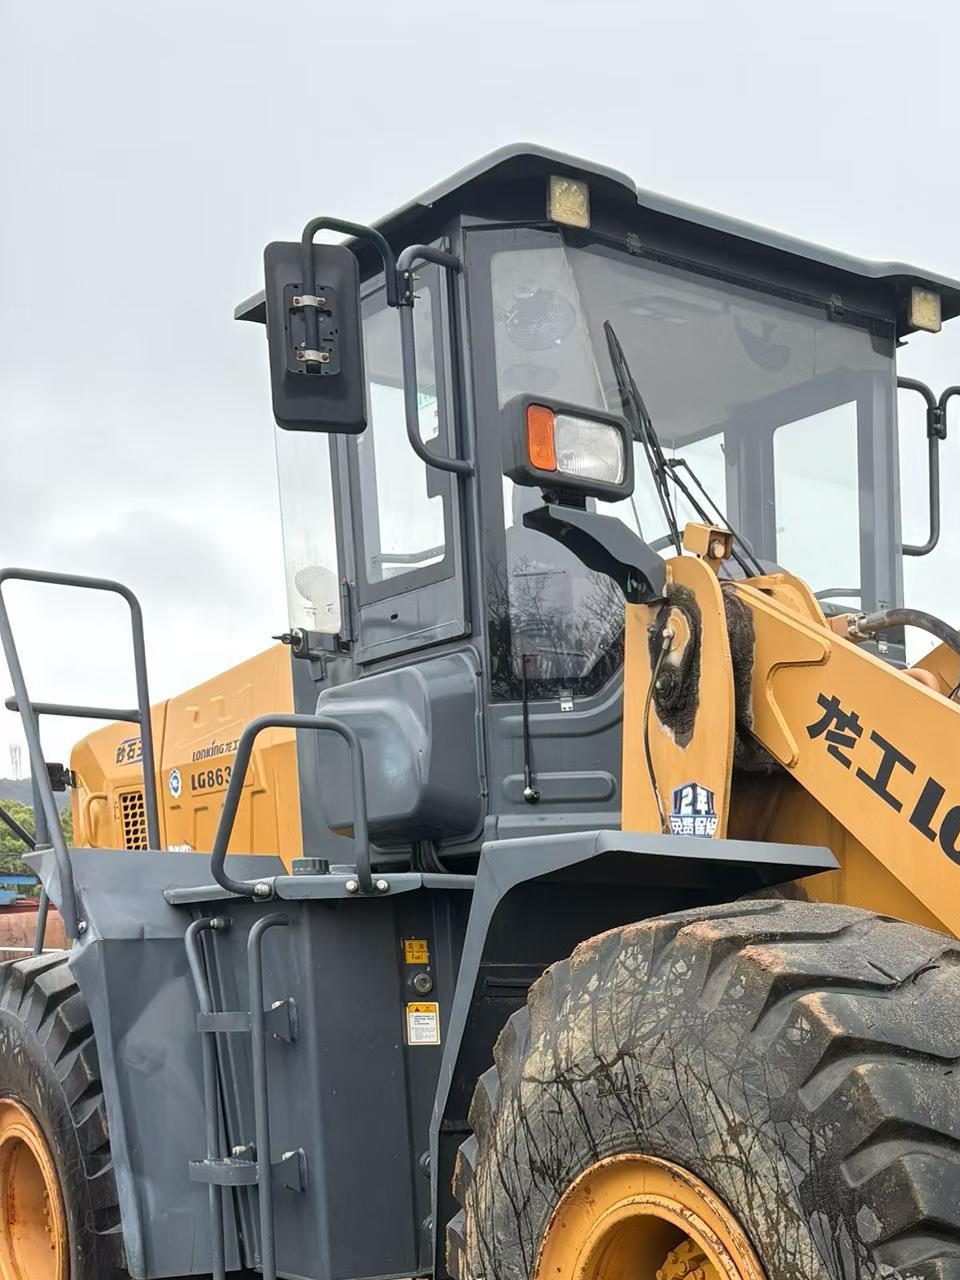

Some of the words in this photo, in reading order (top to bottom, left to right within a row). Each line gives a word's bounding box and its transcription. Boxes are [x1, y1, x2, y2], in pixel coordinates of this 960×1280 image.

[806, 692, 916, 813] 龙工
[191, 766, 232, 791] LG863
[681, 786, 709, 815] 2年
